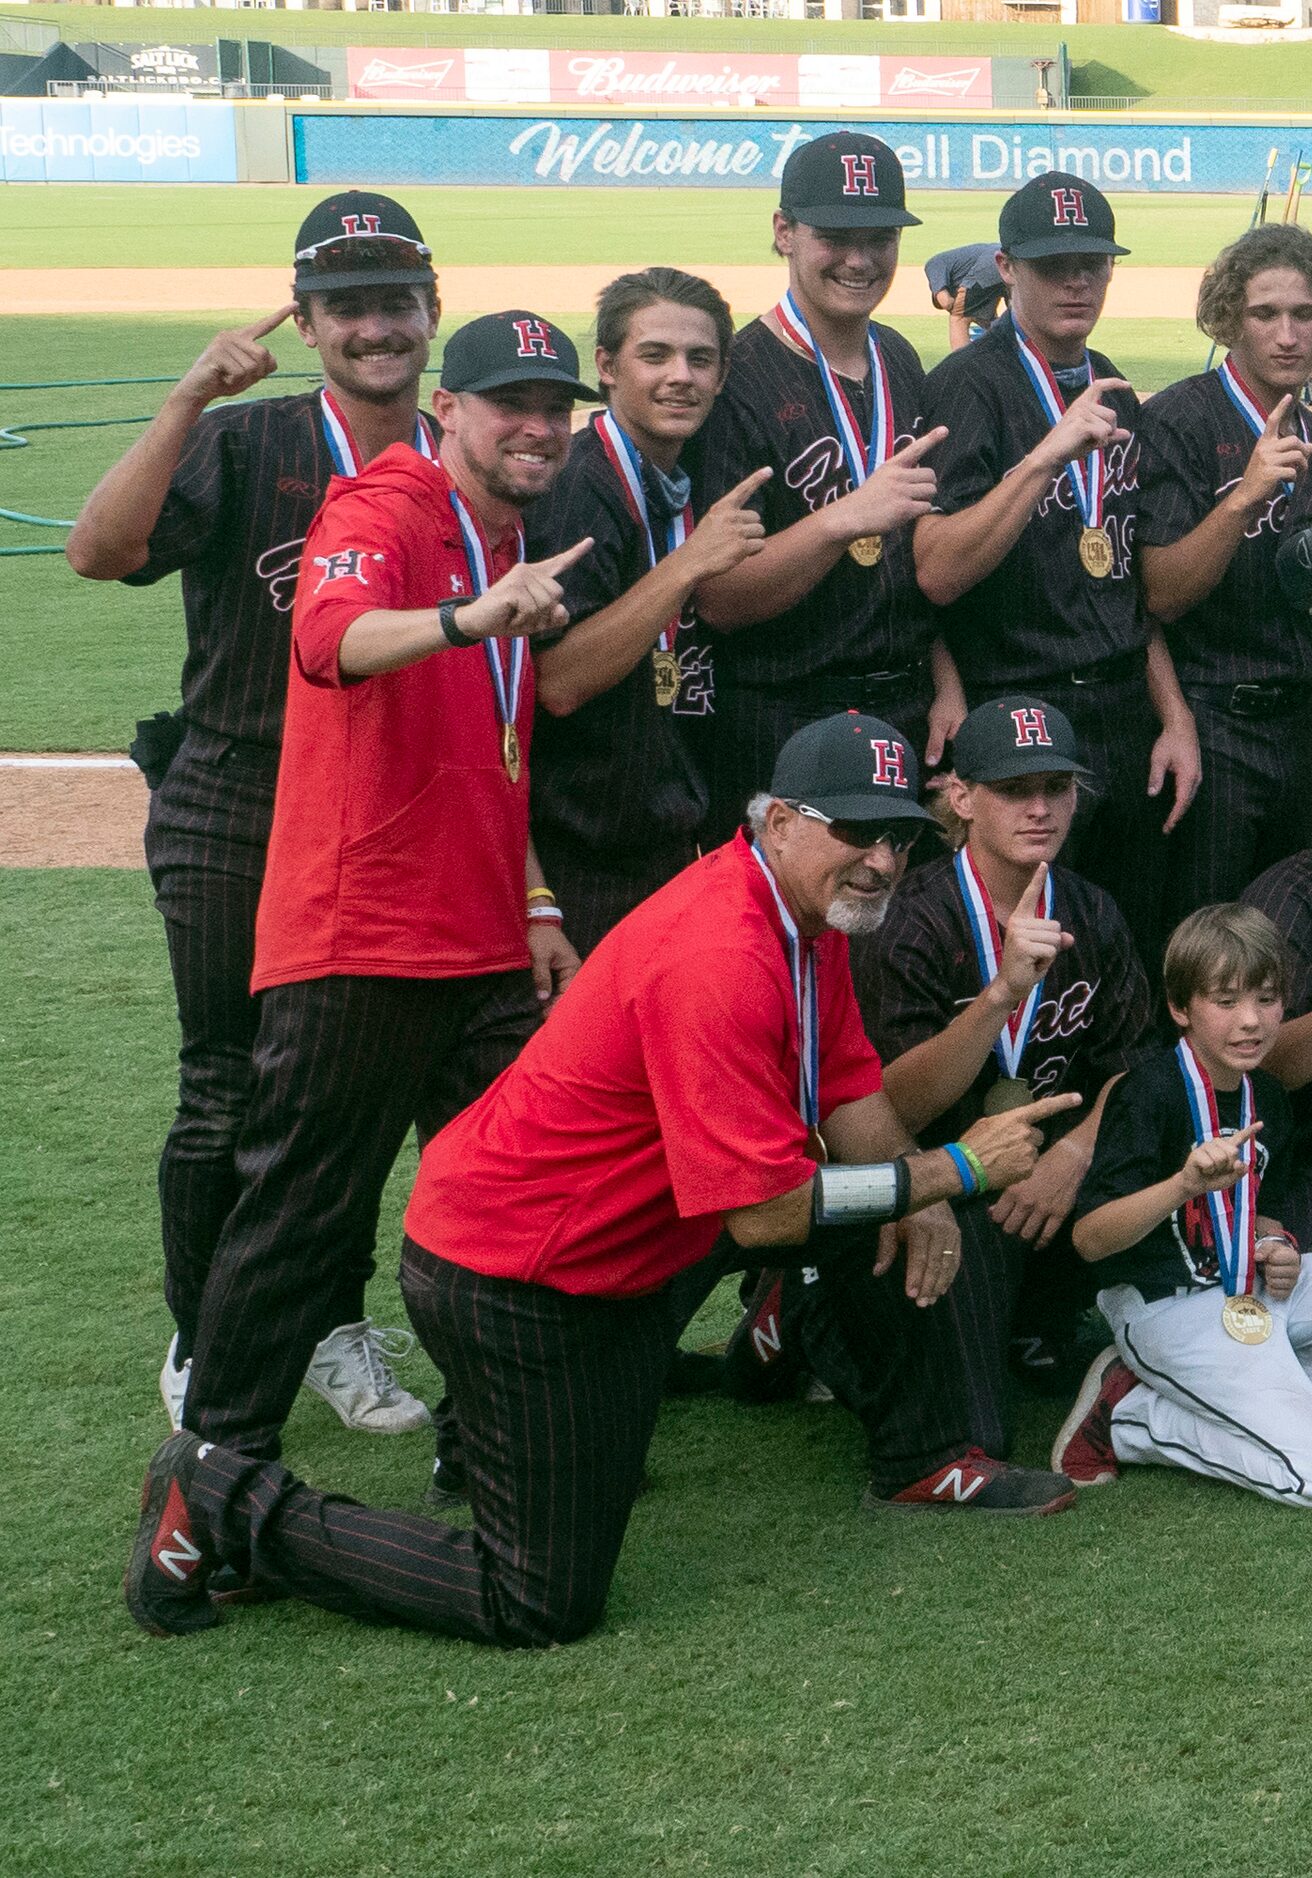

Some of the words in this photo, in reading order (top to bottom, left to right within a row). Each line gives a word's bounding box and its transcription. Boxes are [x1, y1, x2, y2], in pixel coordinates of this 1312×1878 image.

[568, 57, 781, 95] Budweiser
[0, 126, 201, 165] Technologies
[509, 122, 764, 183] Welcome
[770, 124, 813, 178] t
[865, 132, 951, 180] ell
[971, 134, 1191, 182] Diamond
[841, 154, 880, 196] H
[1051, 187, 1090, 226] H
[512, 319, 559, 360] H
[1010, 707, 1054, 748] H
[870, 738, 909, 789] H
[931, 1467, 985, 1503] N
